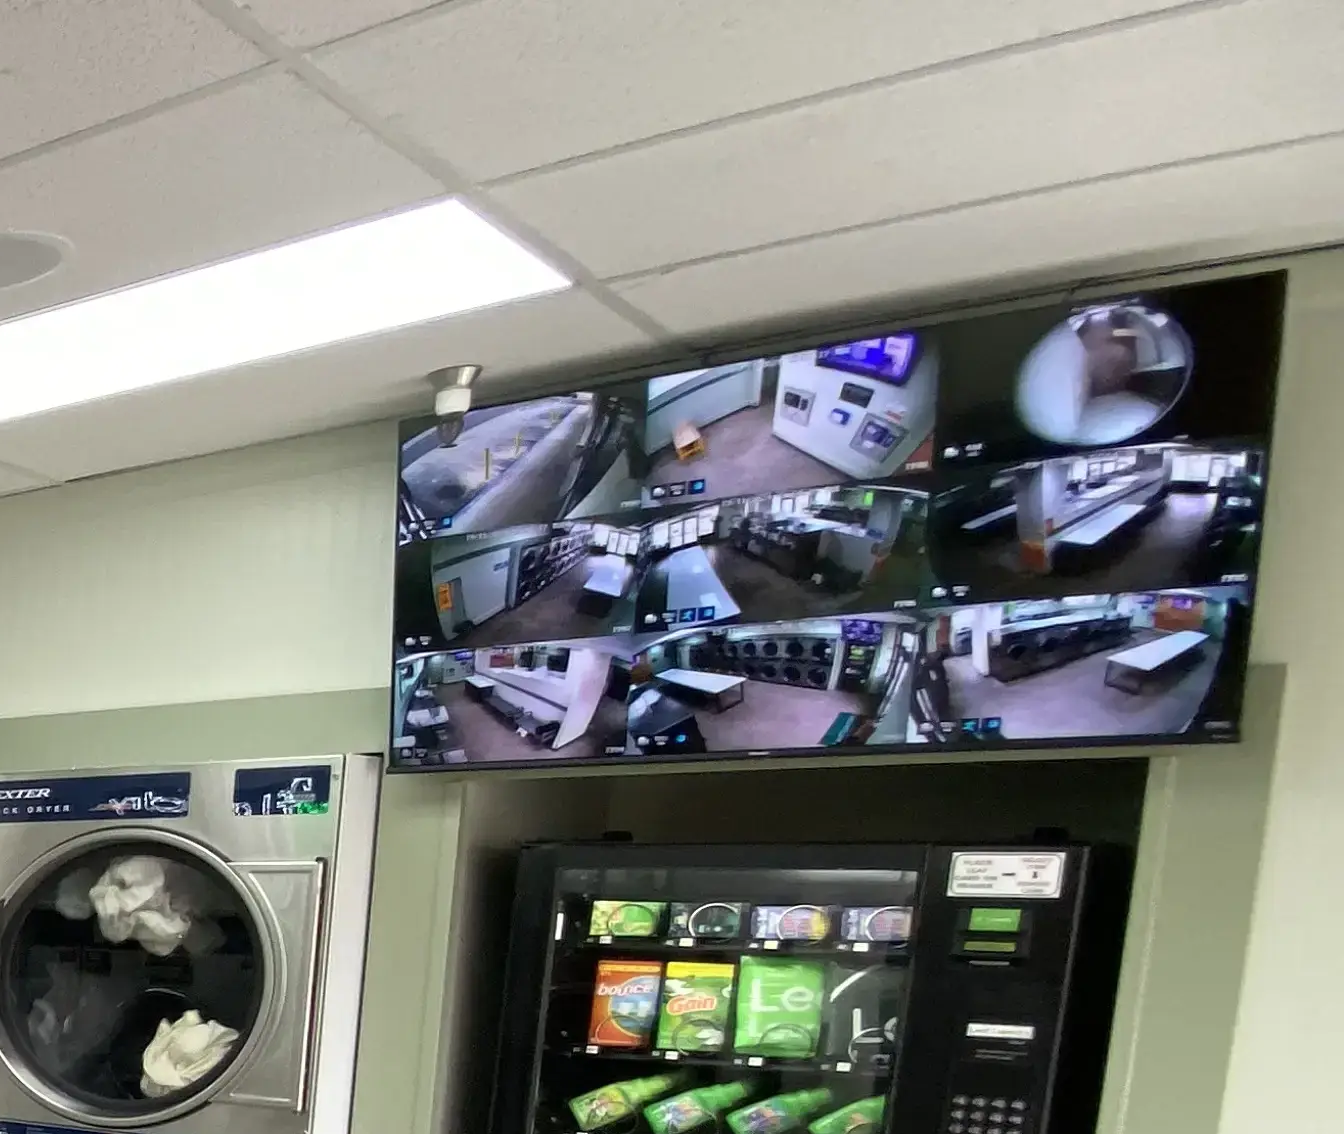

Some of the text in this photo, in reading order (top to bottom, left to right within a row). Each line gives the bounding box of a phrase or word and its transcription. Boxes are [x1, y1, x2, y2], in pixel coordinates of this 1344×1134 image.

[27, 805, 71, 813] DRYER
[598, 983, 653, 996] bounce
[671, 996, 715, 1012] Gain
